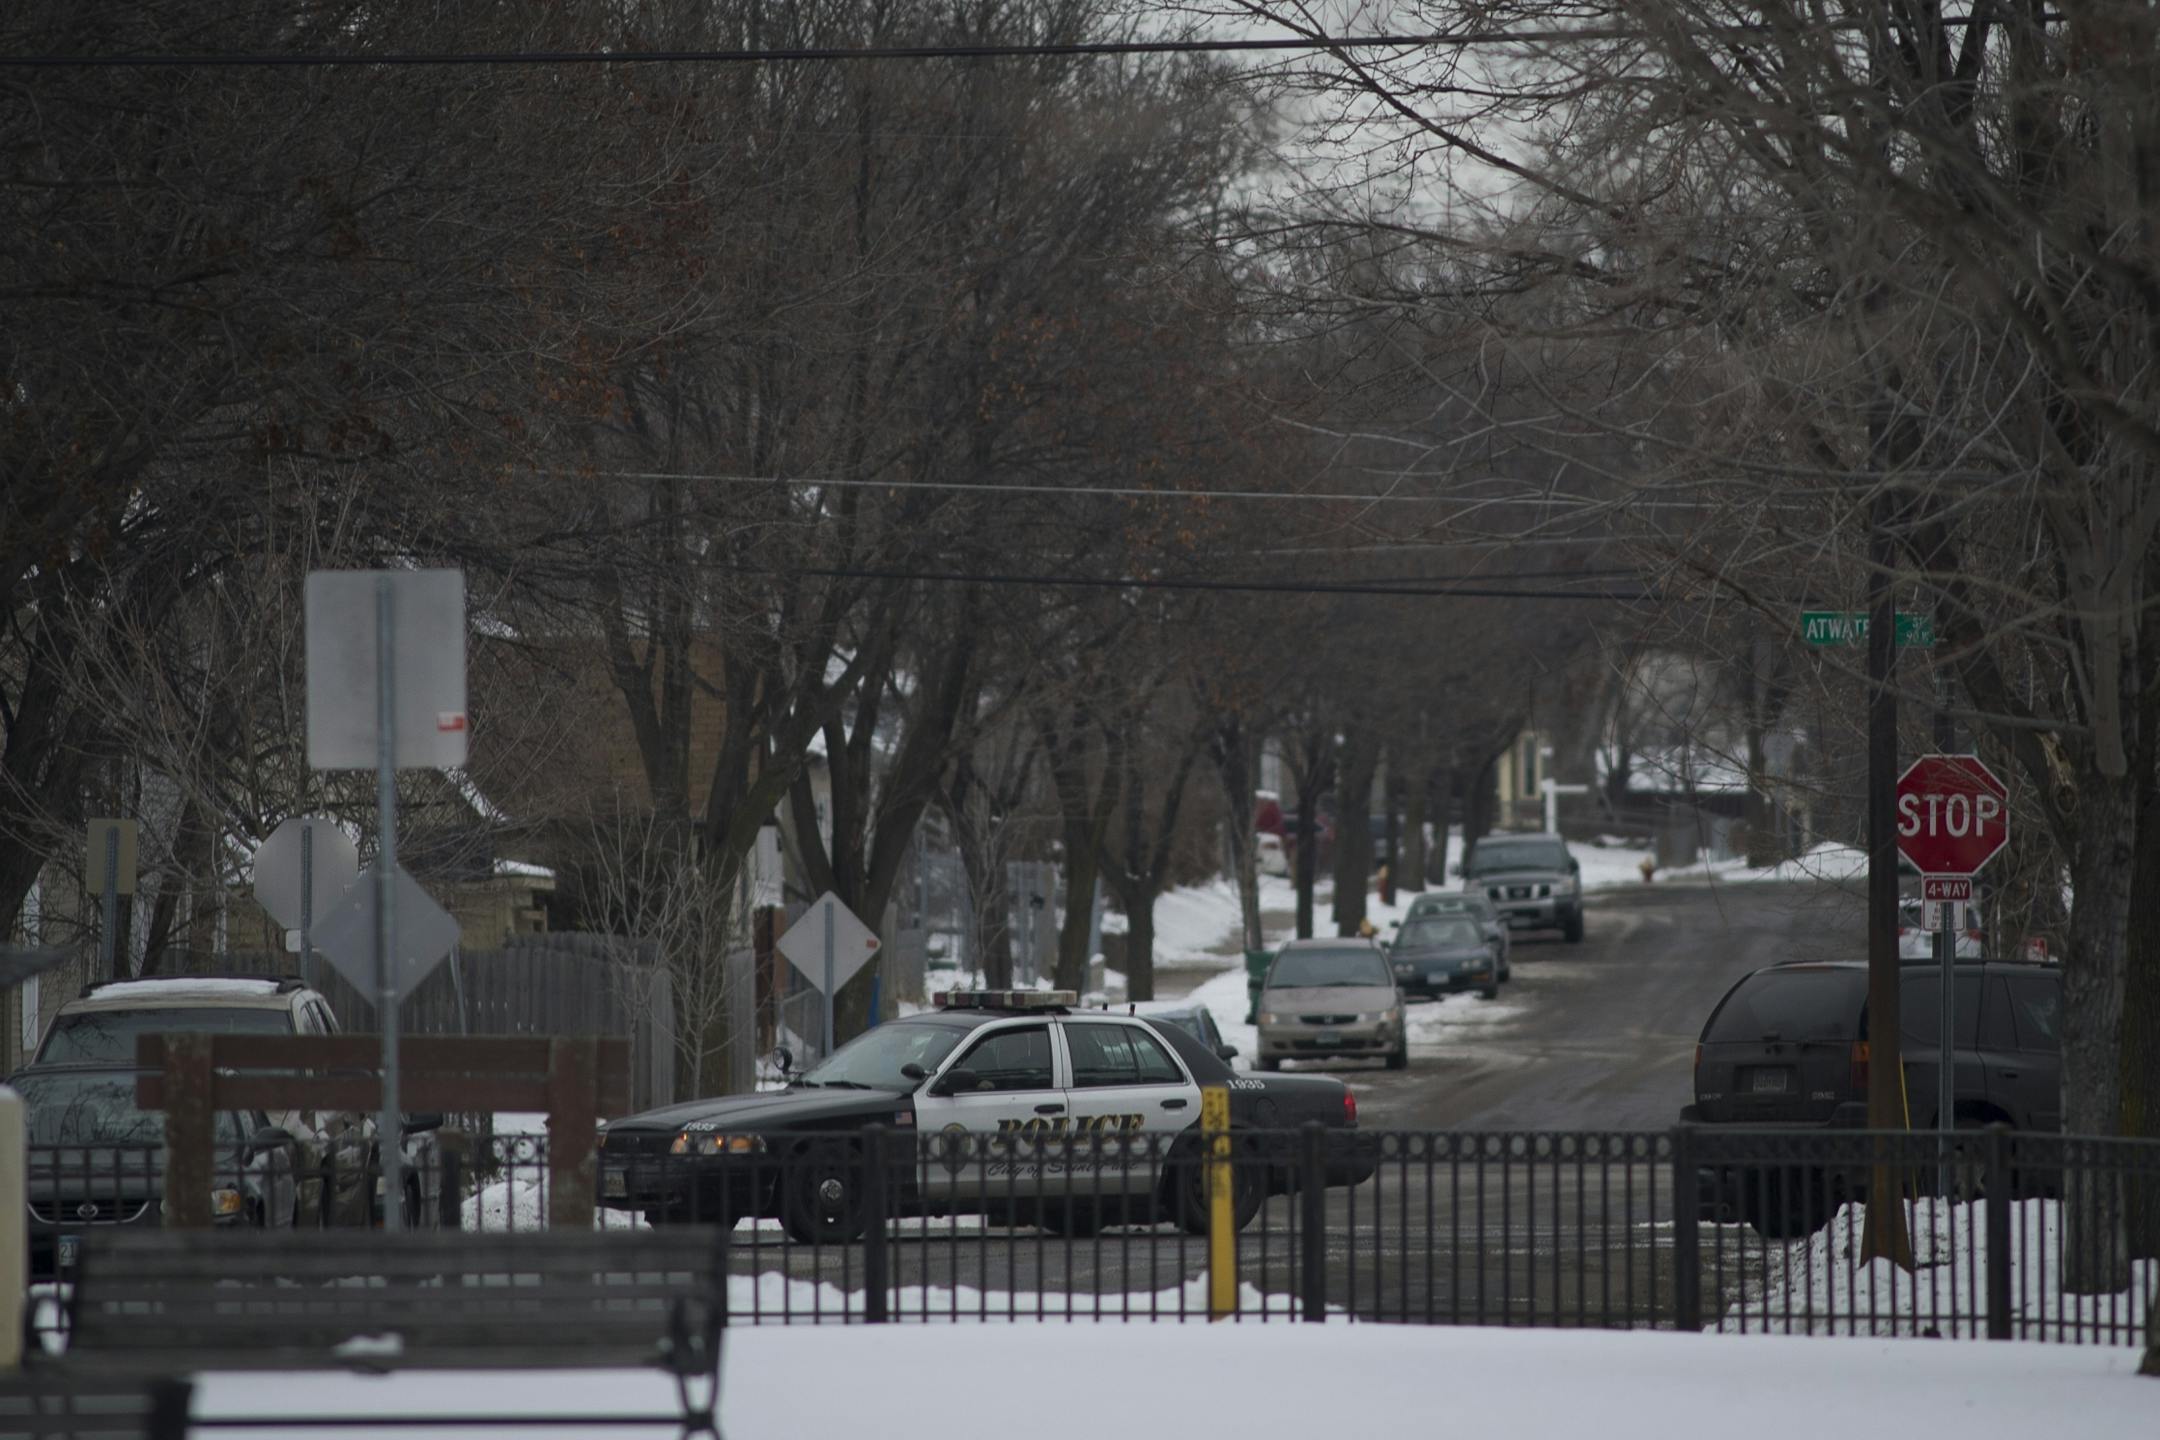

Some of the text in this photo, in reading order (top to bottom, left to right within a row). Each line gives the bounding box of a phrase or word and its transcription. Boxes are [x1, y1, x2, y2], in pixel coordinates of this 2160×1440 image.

[1806, 617, 1870, 639] ATWATE
[1897, 792, 2000, 838] STOP
[1928, 882, 1968, 898] 4-WAY
[1226, 1079, 1266, 1090] 1935
[991, 1112, 1145, 1148] POLICE
[986, 1157, 1025, 1179] Ciy
[1047, 1157, 1091, 1174] Sint
